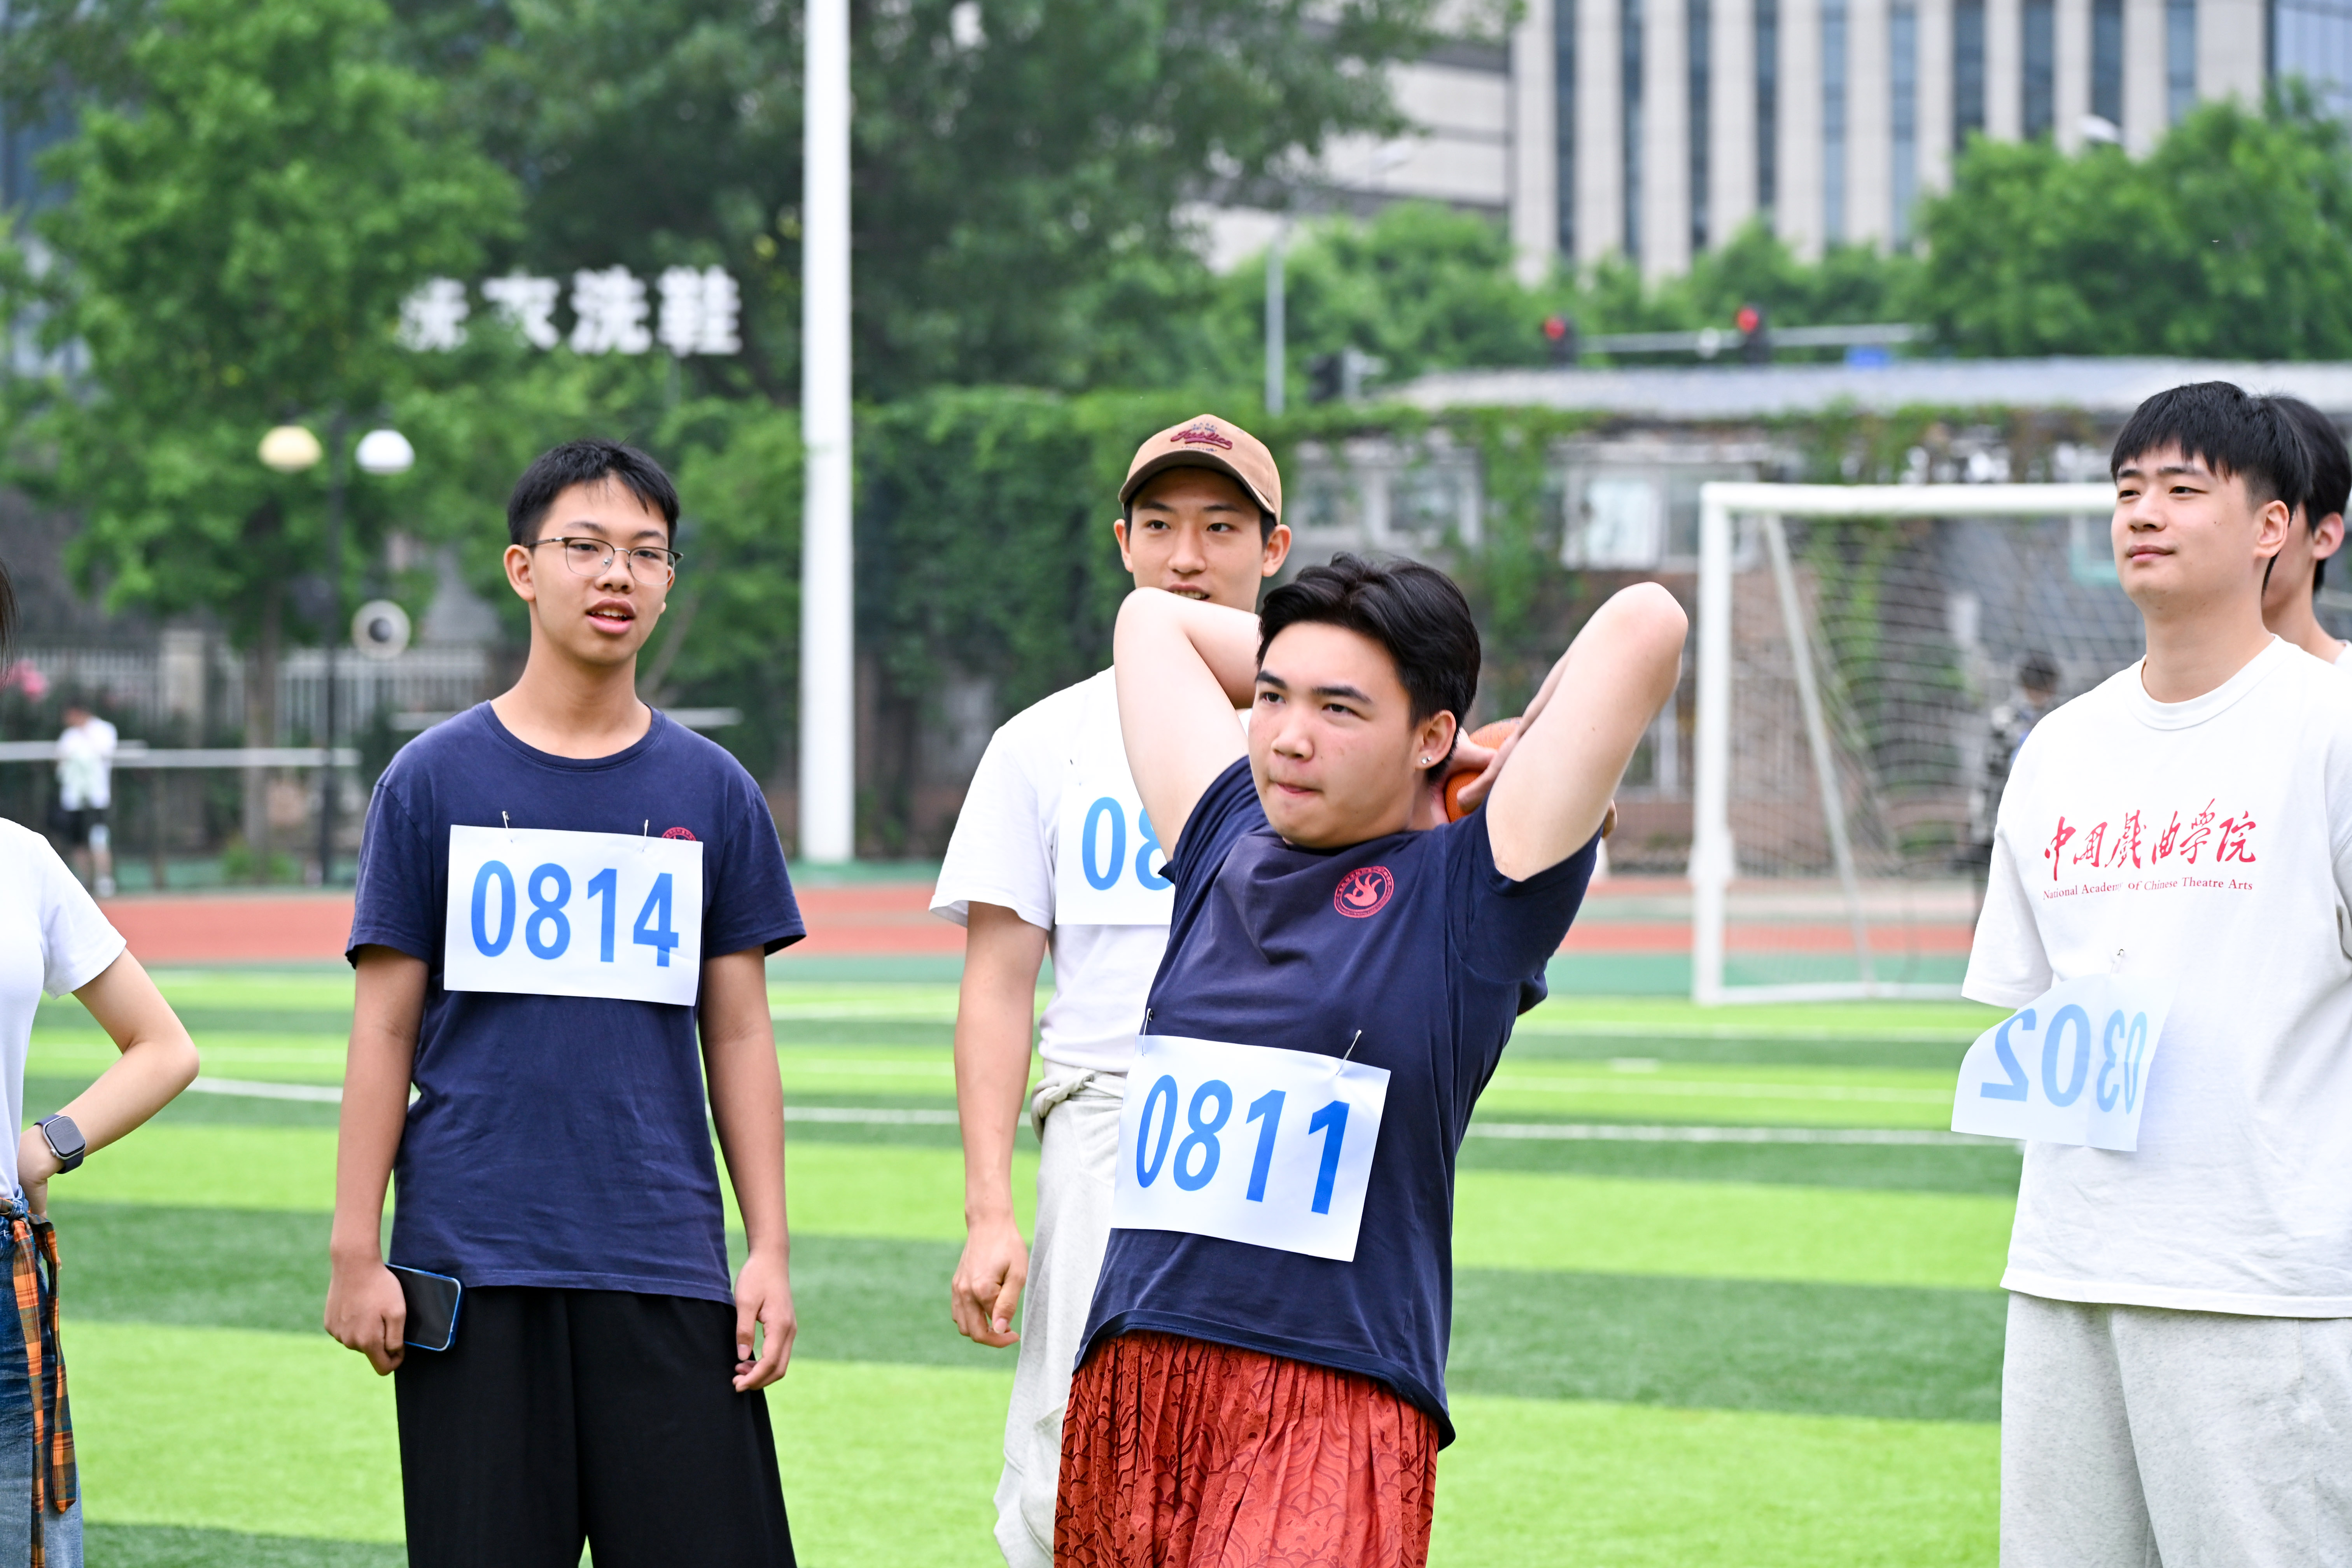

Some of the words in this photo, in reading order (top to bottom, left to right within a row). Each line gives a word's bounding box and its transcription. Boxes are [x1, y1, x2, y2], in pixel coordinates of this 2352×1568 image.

[471, 860, 679, 968] 0814
[2043, 885, 2077, 900] National
[2128, 881, 2142, 891] of
[2144, 880, 2178, 891] Chinese
[2182, 877, 2224, 888] Theatre
[2228, 879, 2252, 891] Arts
[1136, 1074, 1350, 1215] 0811
